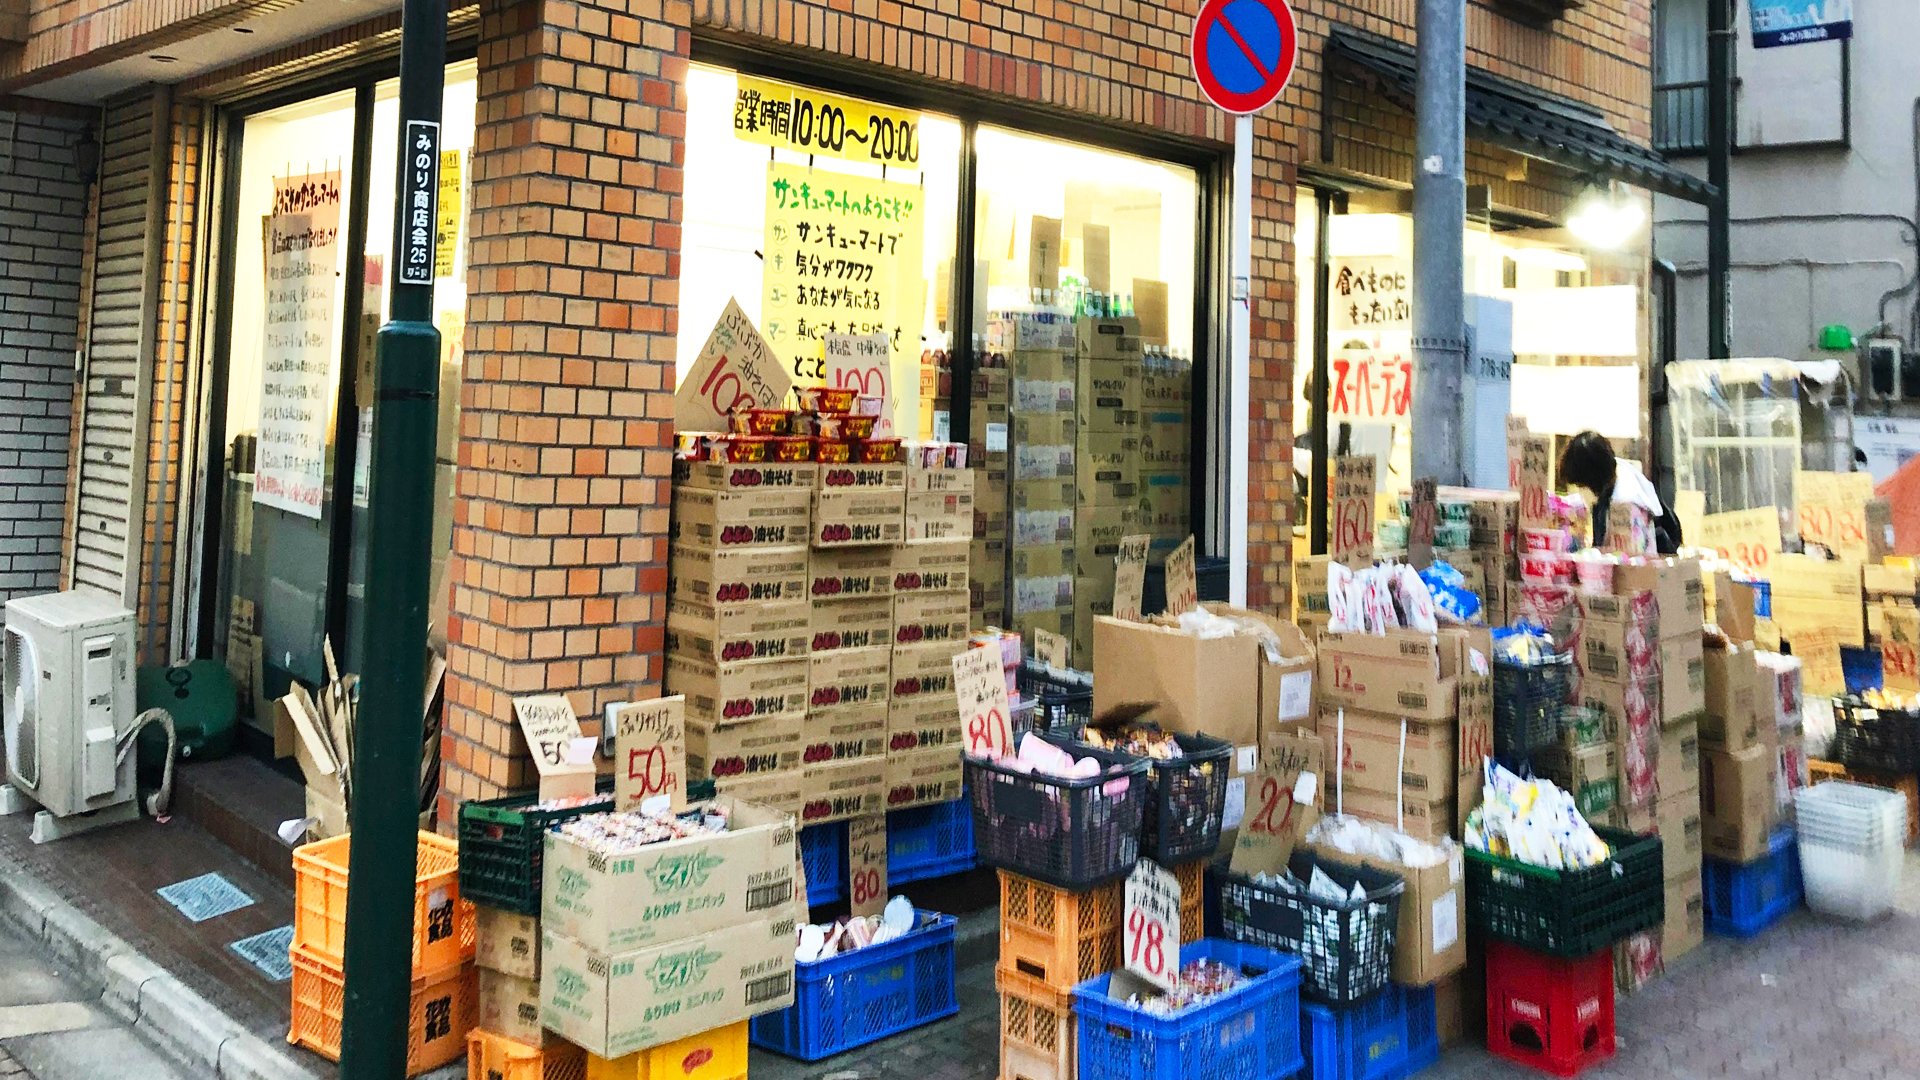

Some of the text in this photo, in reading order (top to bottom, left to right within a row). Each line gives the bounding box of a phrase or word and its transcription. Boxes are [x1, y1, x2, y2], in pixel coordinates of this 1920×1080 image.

[734, 89, 791, 140] 営業時間
[410, 134, 432, 264] みのり商店会 25
[796, 221, 903, 255] サンキューマートで
[796, 250, 874, 283] 気分がワクワク
[1336, 266, 1406, 296] 食べものに
[796, 283, 880, 310] あなたが気になる
[726, 309, 766, 363] ぶぶか
[738, 356, 777, 409] 油そば
[763, 469, 792, 486] 油そば
[856, 468, 883, 486] 油そば
[754, 524, 784, 542] 油そば
[852, 524, 880, 542] 油そば
[750, 582, 781, 600] 油そば
[853, 868, 880, 905] 80
